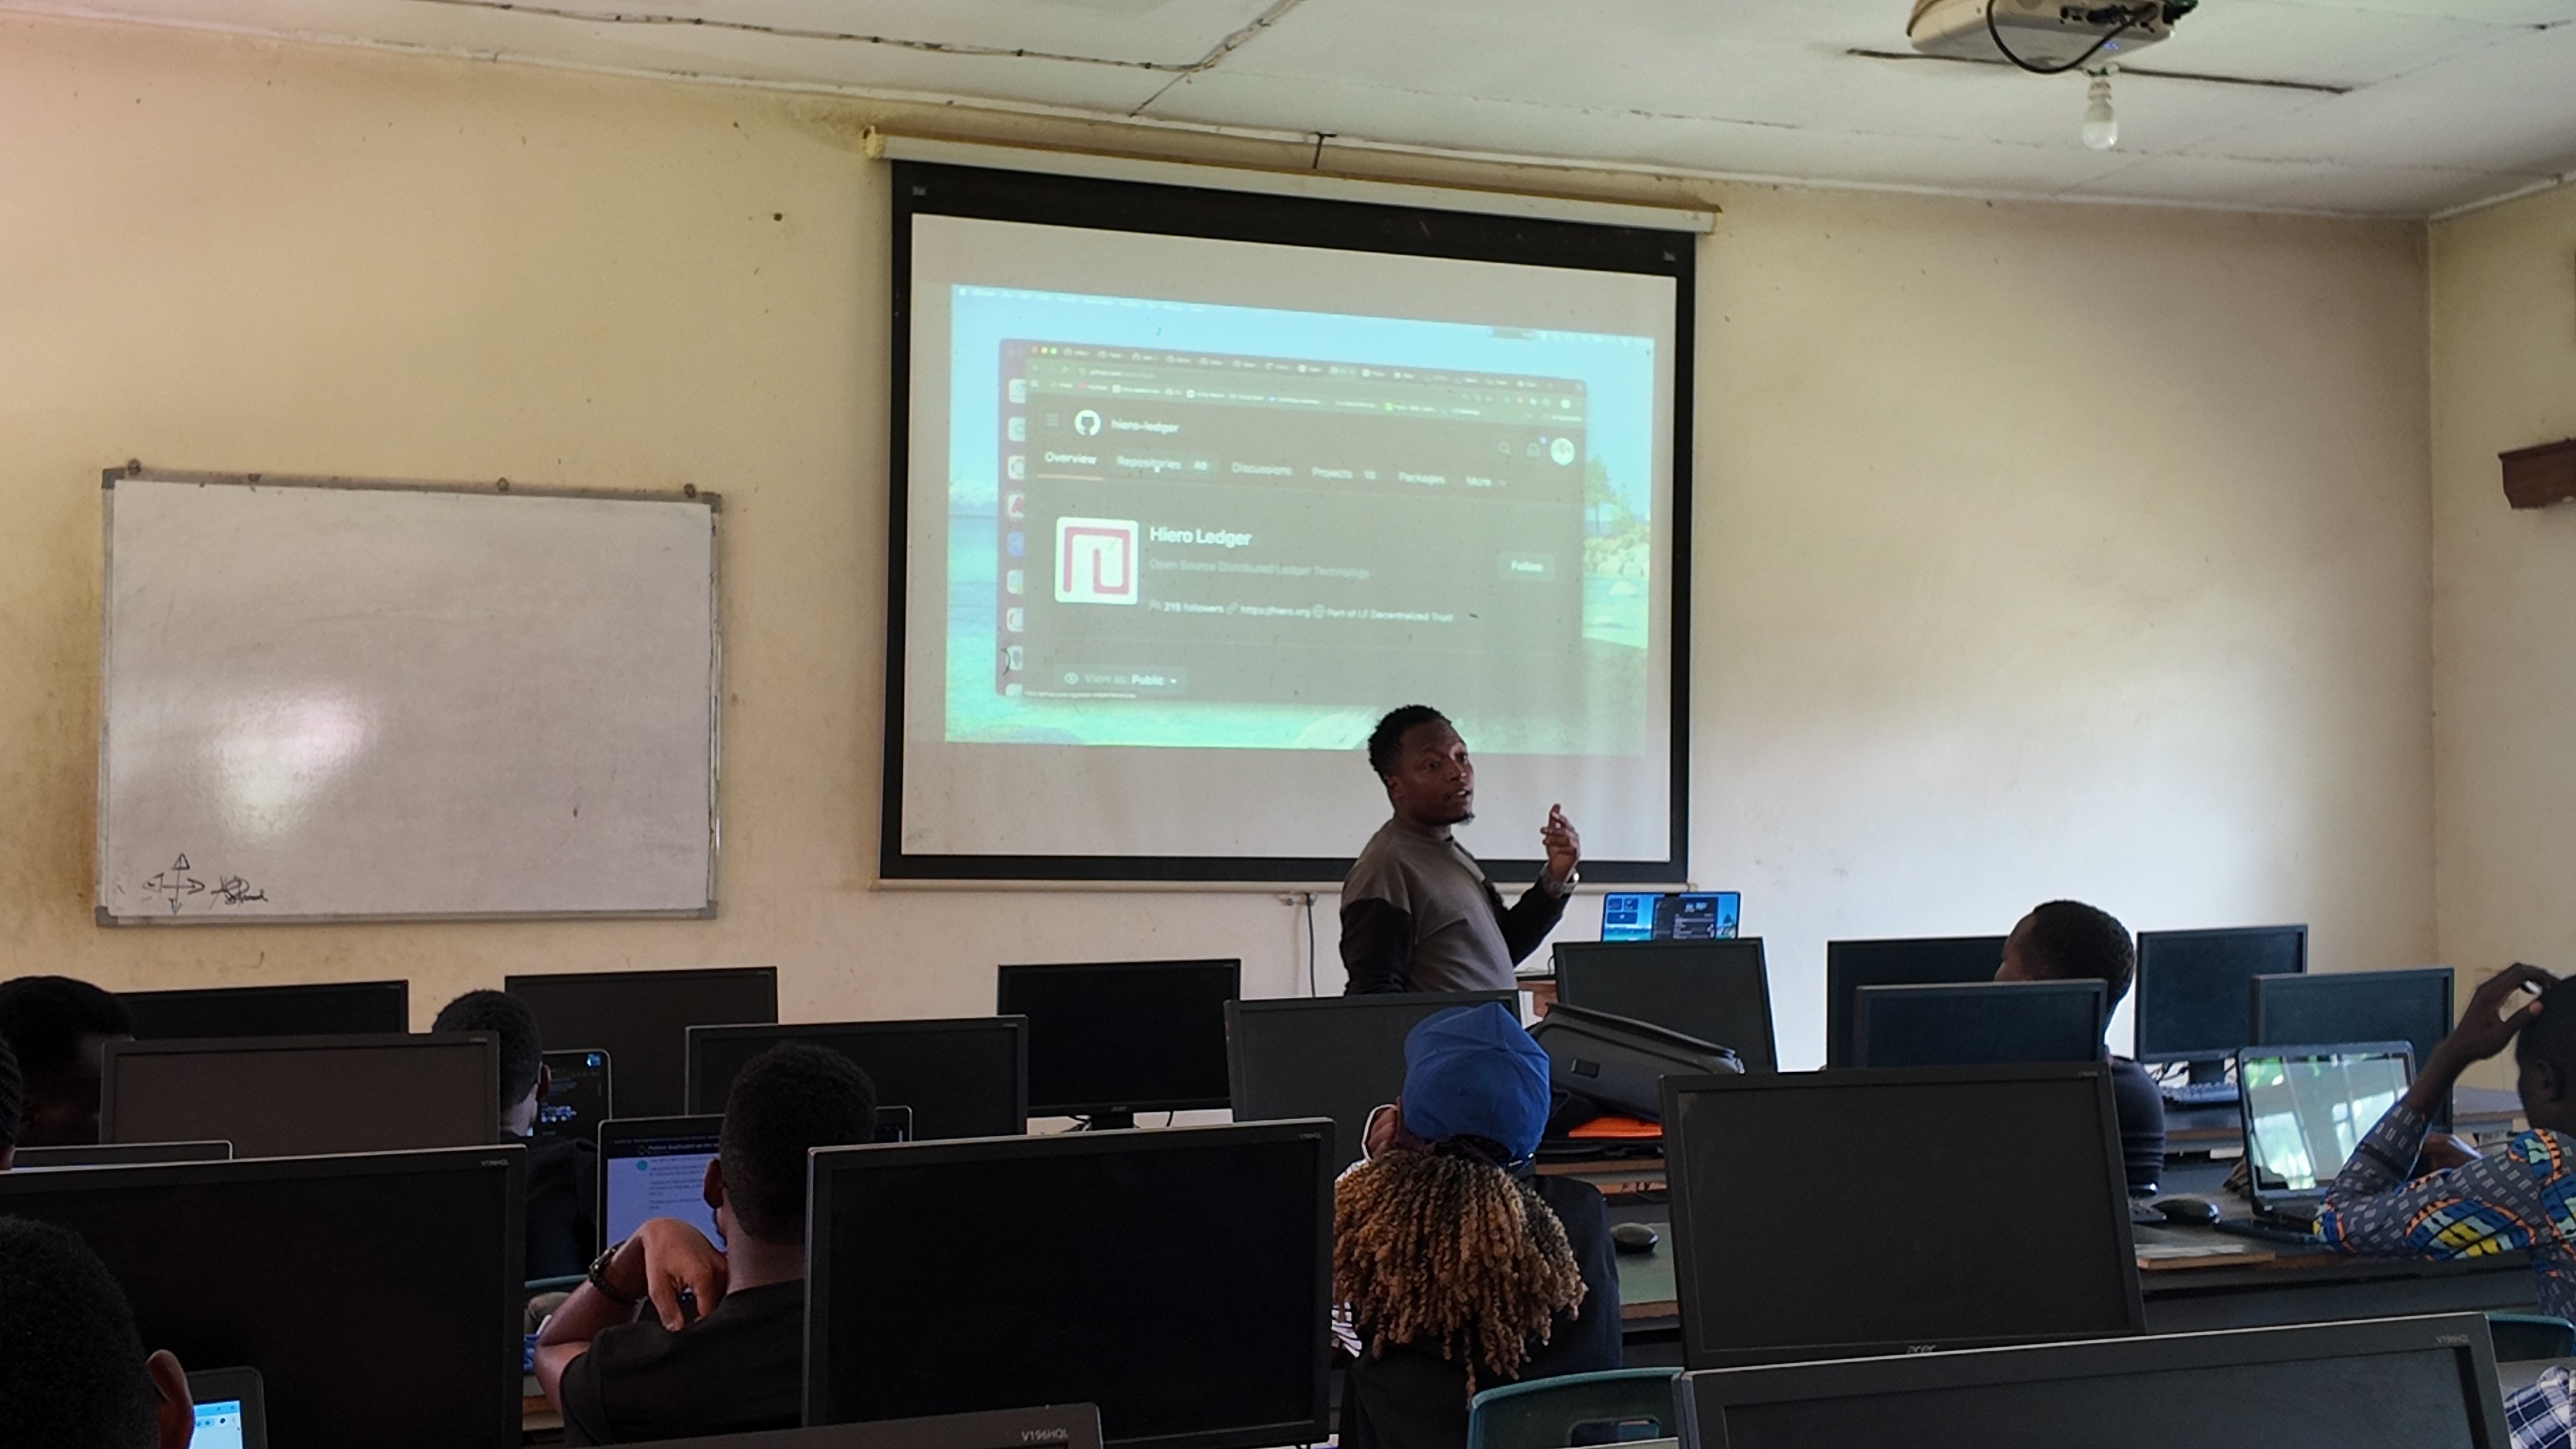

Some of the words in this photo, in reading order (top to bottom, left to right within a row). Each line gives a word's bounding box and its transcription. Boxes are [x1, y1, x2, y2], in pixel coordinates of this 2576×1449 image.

[1111, 419, 1179, 434] hiero-ledger
[1044, 451, 1097, 465] Overview
[1116, 455, 1181, 470] Repositories
[1232, 462, 1293, 476] Discussions
[1311, 466, 1353, 480] Projects
[1398, 472, 1446, 486] Packages
[1466, 476, 1492, 487] More
[1150, 526, 1193, 543] Hiero
[1196, 528, 1252, 548] Ledger
[1511, 560, 1543, 572] Follow
[1131, 674, 1165, 686] Public
